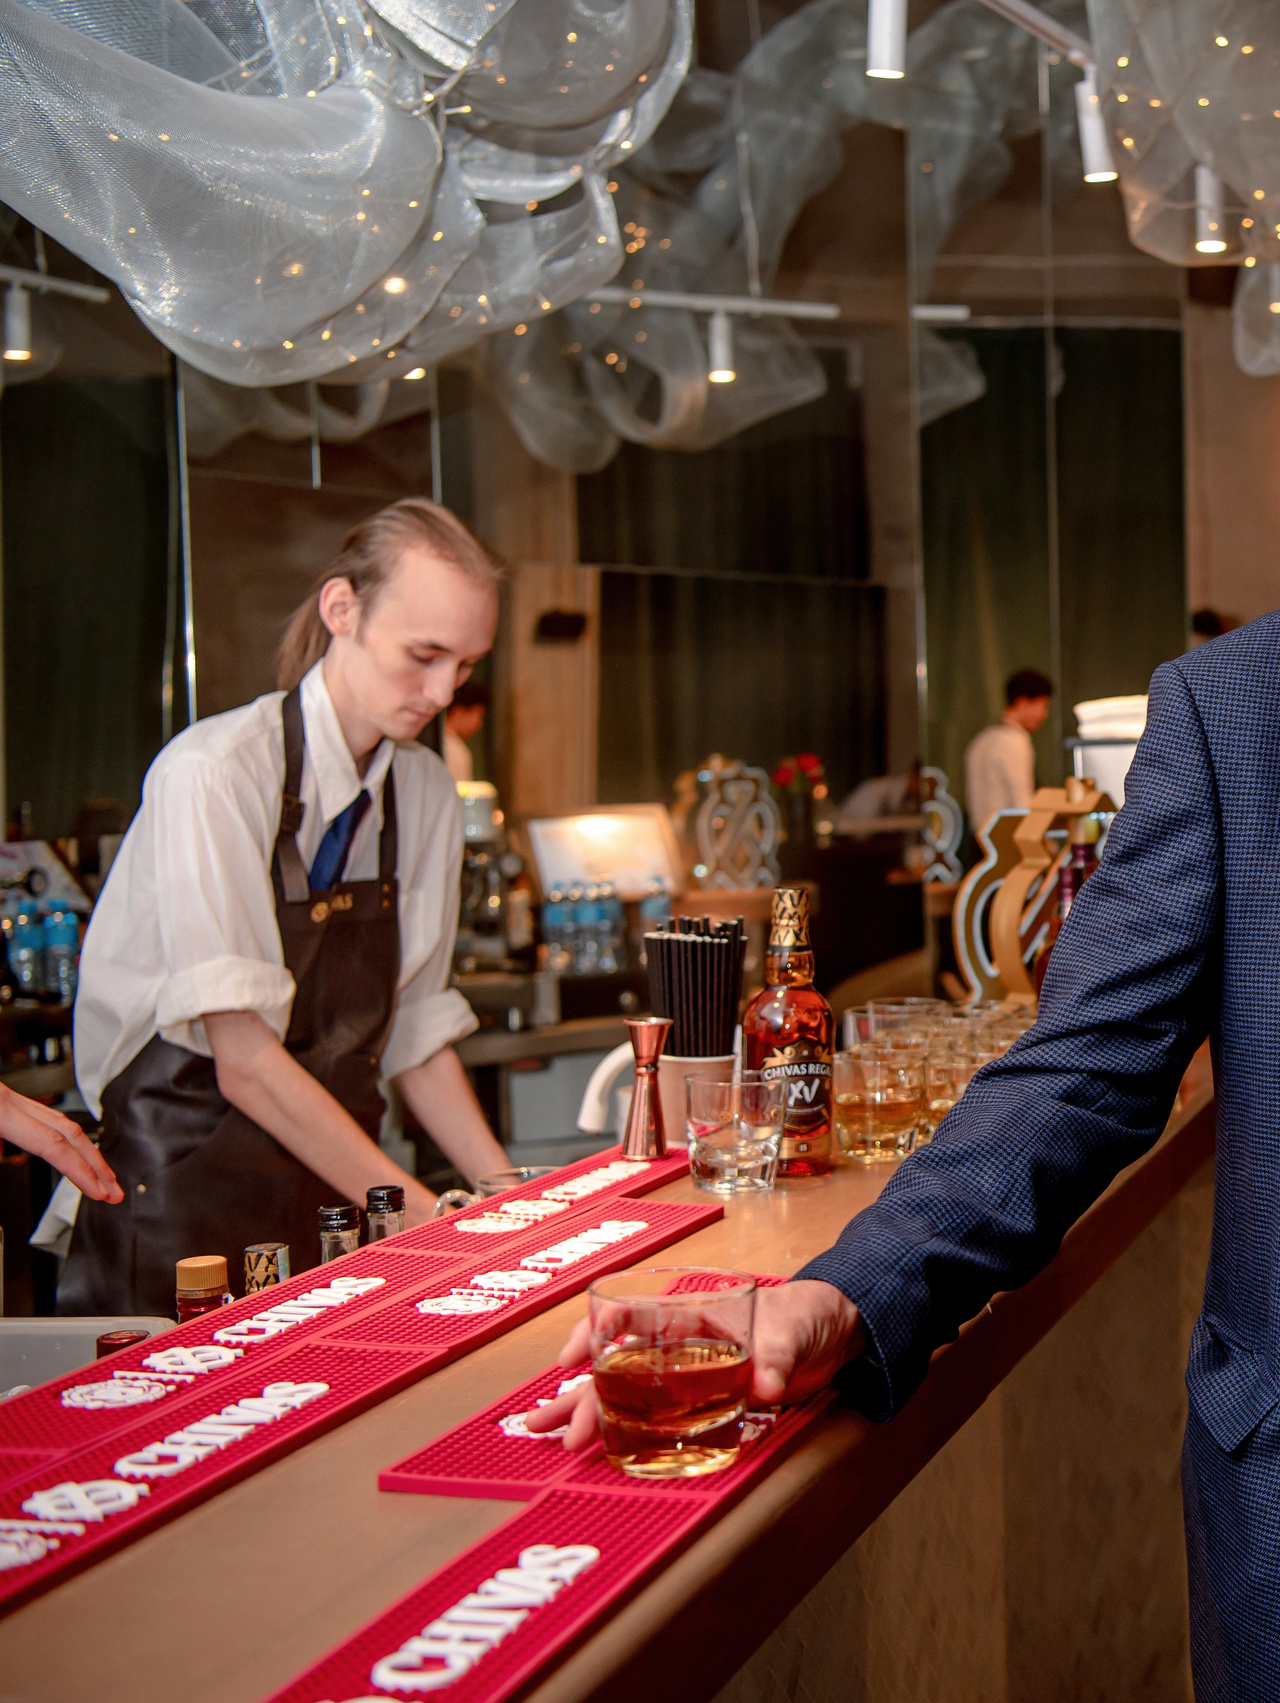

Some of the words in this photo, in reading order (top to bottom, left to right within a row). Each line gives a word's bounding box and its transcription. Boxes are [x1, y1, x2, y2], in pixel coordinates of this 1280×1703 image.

[763, 1063, 807, 1080] CHIVAS
[808, 1063, 832, 1077] REGA
[787, 1078, 820, 1107] XV
[541, 1161, 651, 1200] CHIVAS
[520, 1220, 649, 1269] CHIVAS
[213, 1277, 387, 1344] CHIVAS
[113, 1381, 330, 1478] CHIVAS
[370, 1544, 600, 1692] CHIVAS
